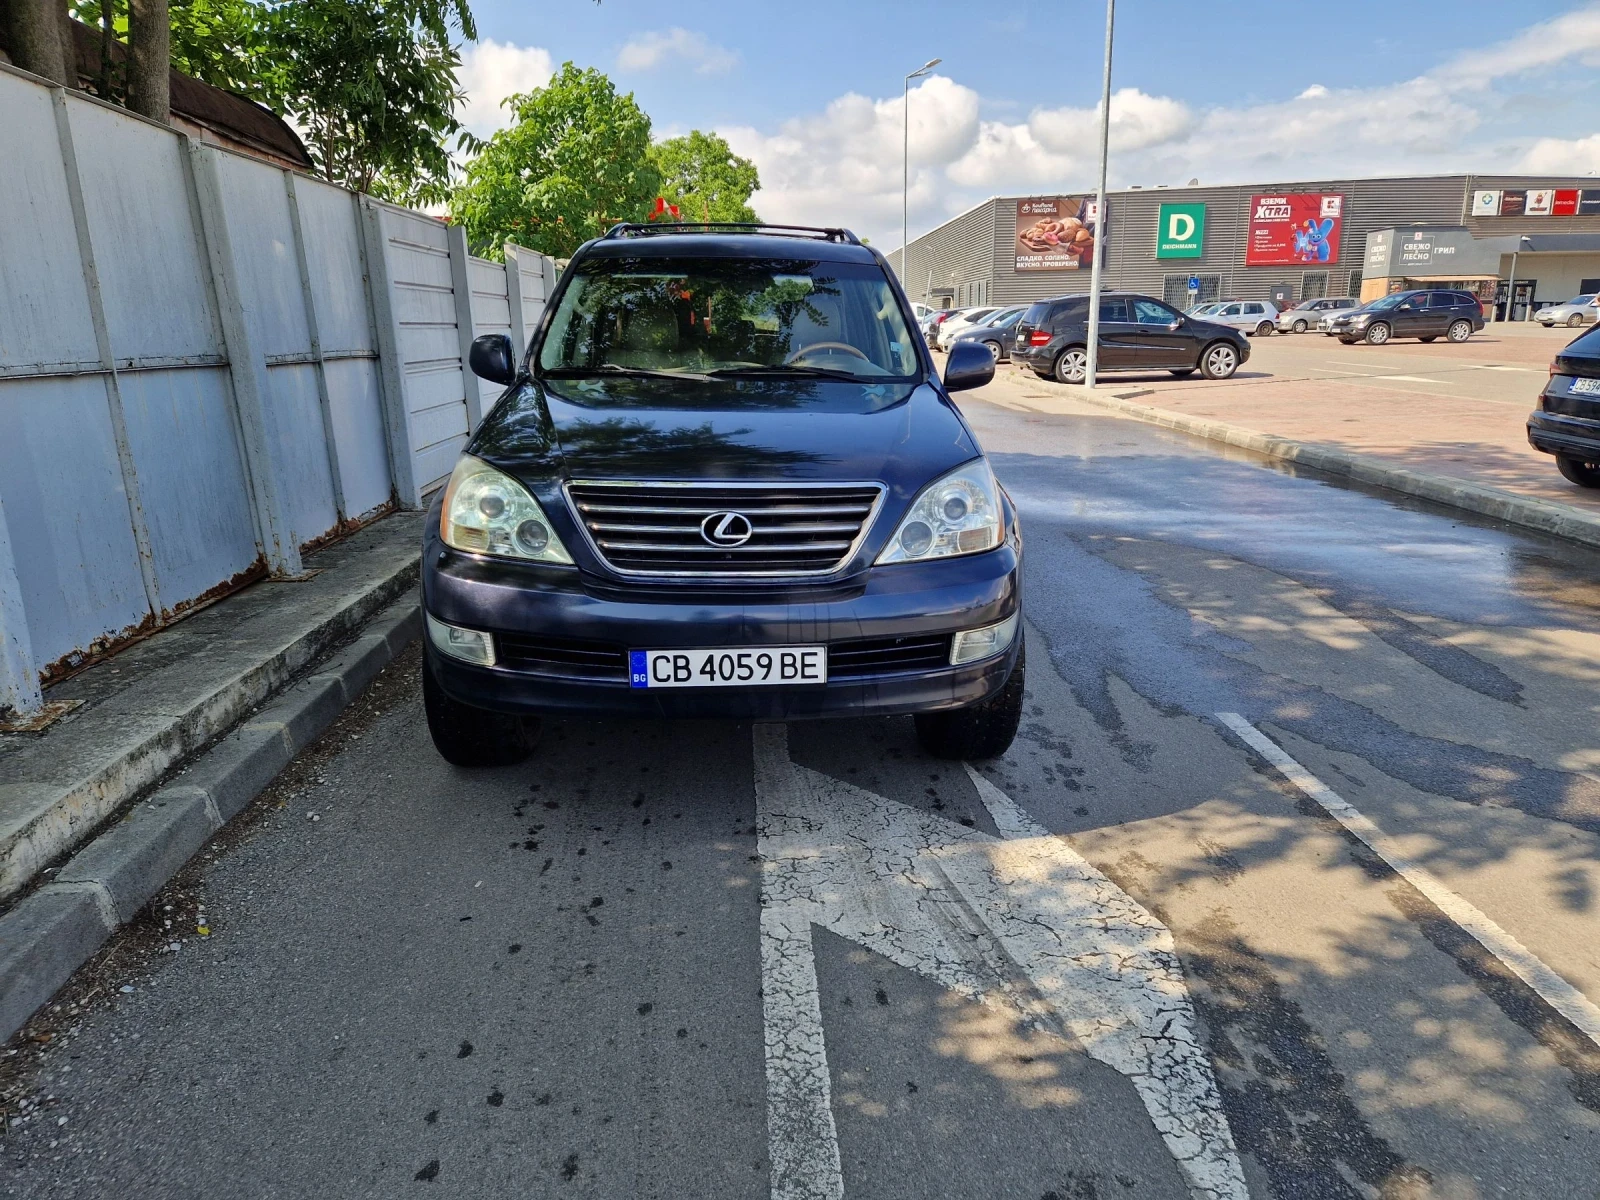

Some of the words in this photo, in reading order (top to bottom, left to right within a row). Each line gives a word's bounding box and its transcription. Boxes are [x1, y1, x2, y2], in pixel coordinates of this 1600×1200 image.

[1254, 205, 1291, 219] XTRA
[1169, 213, 1195, 241] D
[652, 654, 692, 683] CB
[699, 653, 773, 682] 4059
[780, 651, 819, 680] BE
[633, 673, 647, 683] BG
